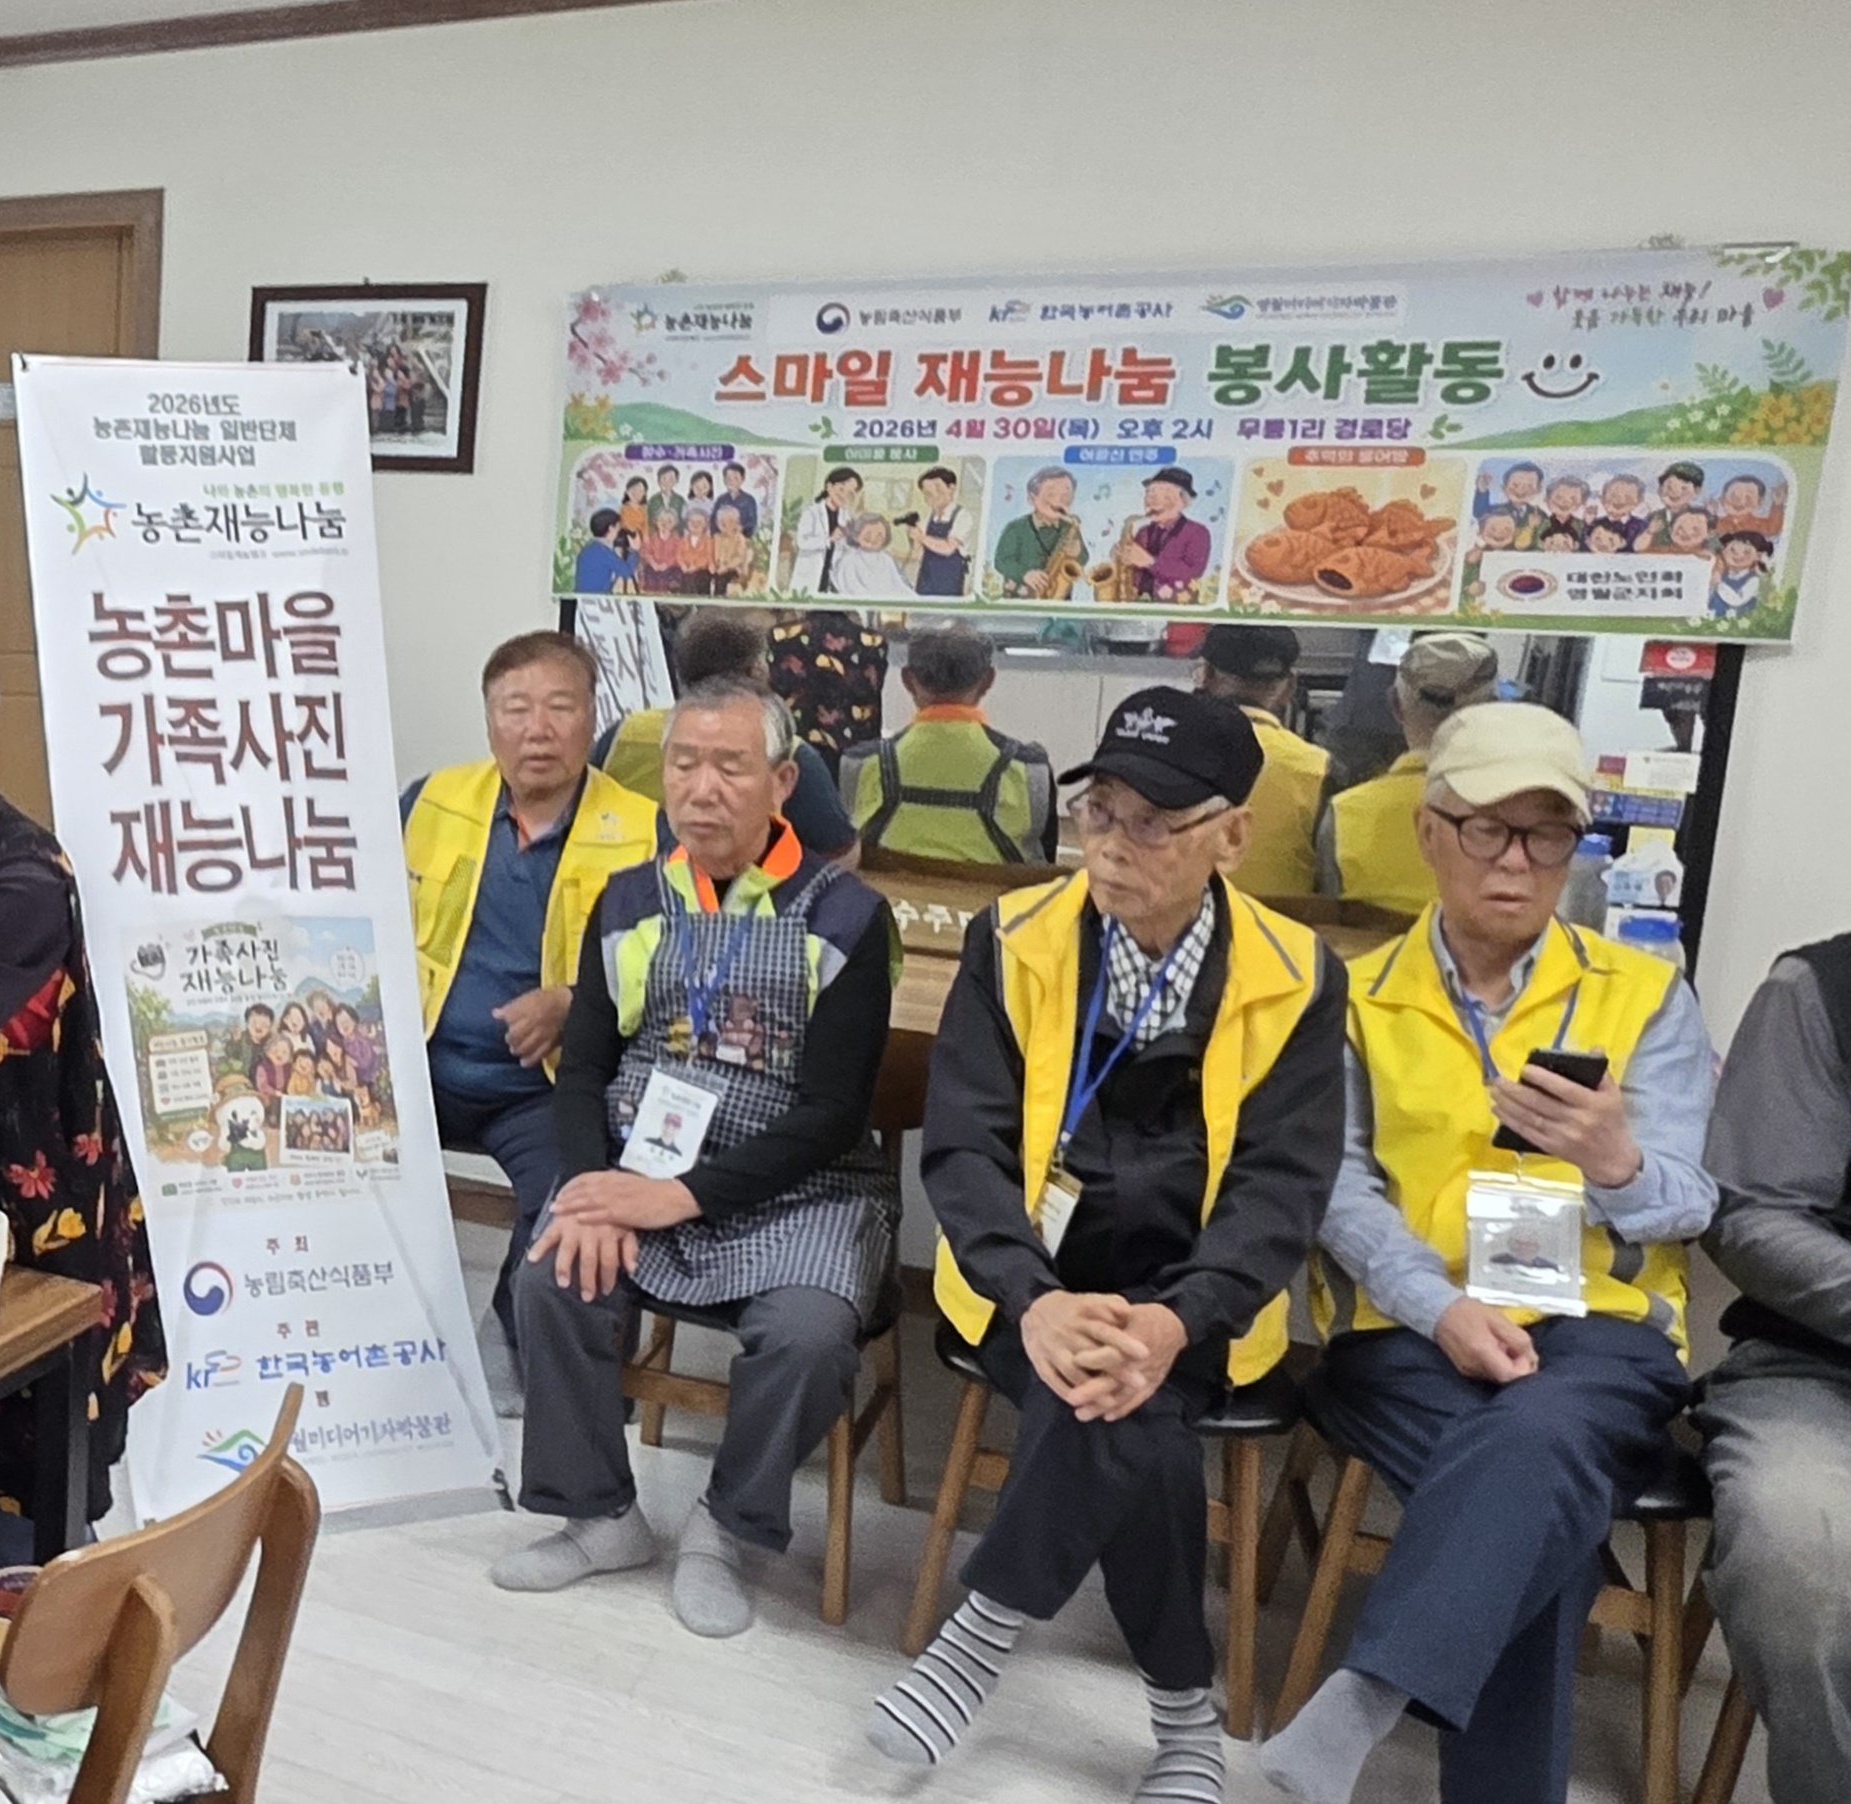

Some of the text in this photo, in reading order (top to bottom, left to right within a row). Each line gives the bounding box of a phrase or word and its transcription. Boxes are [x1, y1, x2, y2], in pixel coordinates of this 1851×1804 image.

[714, 340, 1506, 409] 스마일 재능나눔 봉사활동
[147, 392, 241, 416] 2026년도
[92, 416, 297, 442] 농촌재능나눔 일반단체
[853, 418, 938, 440] 2026년
[945, 418, 986, 439] 4월
[993, 417, 1100, 441] 30일(목)
[1116, 418, 1164, 439] 오후
[1172, 418, 1214, 440] 2시
[1335, 417, 1413, 440] 경로당
[138, 444, 256, 467] 활동지원사업
[131, 501, 347, 544] 농촌재능나눔
[88, 590, 341, 682] 농촌마을
[99, 691, 349, 787] 가족사진
[108, 796, 358, 895] 재능나눔
[893, 899, 974, 934] 수주
[185, 938, 279, 966] 가족사진
[179, 961, 288, 995] 재능나눔
[244, 1261, 394, 1298] 농림축산식품부
[256, 1337, 447, 1380] 한국농어촌공사
[291, 1411, 452, 1453] 월미디어기자박물관
